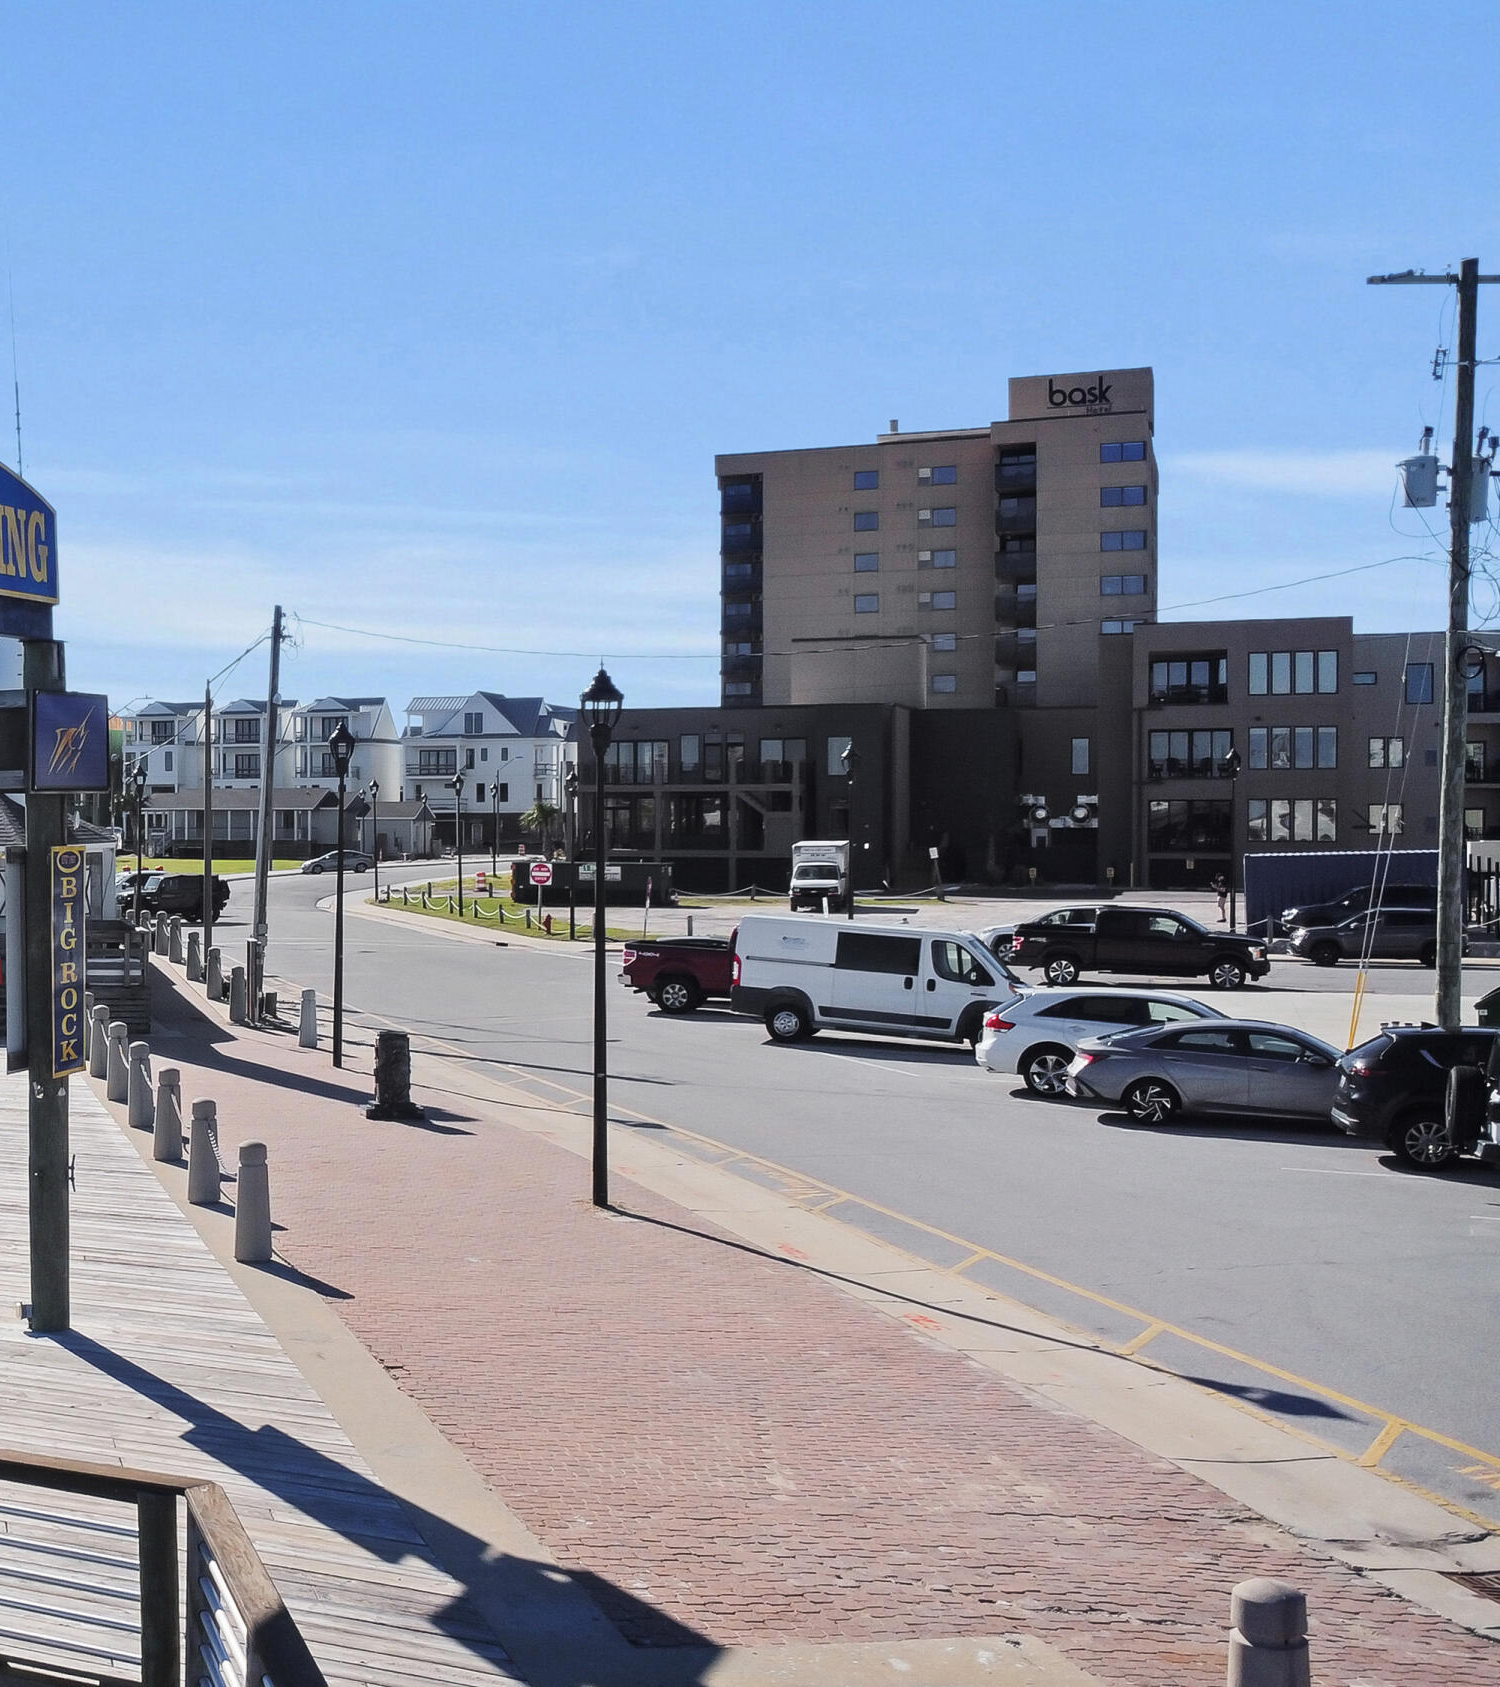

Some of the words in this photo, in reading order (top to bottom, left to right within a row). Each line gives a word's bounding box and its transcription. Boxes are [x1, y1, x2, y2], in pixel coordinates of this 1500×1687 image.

[1048, 376, 1113, 406] bask
[60, 877, 77, 950] BIG
[60, 962, 78, 1061] ROCK
